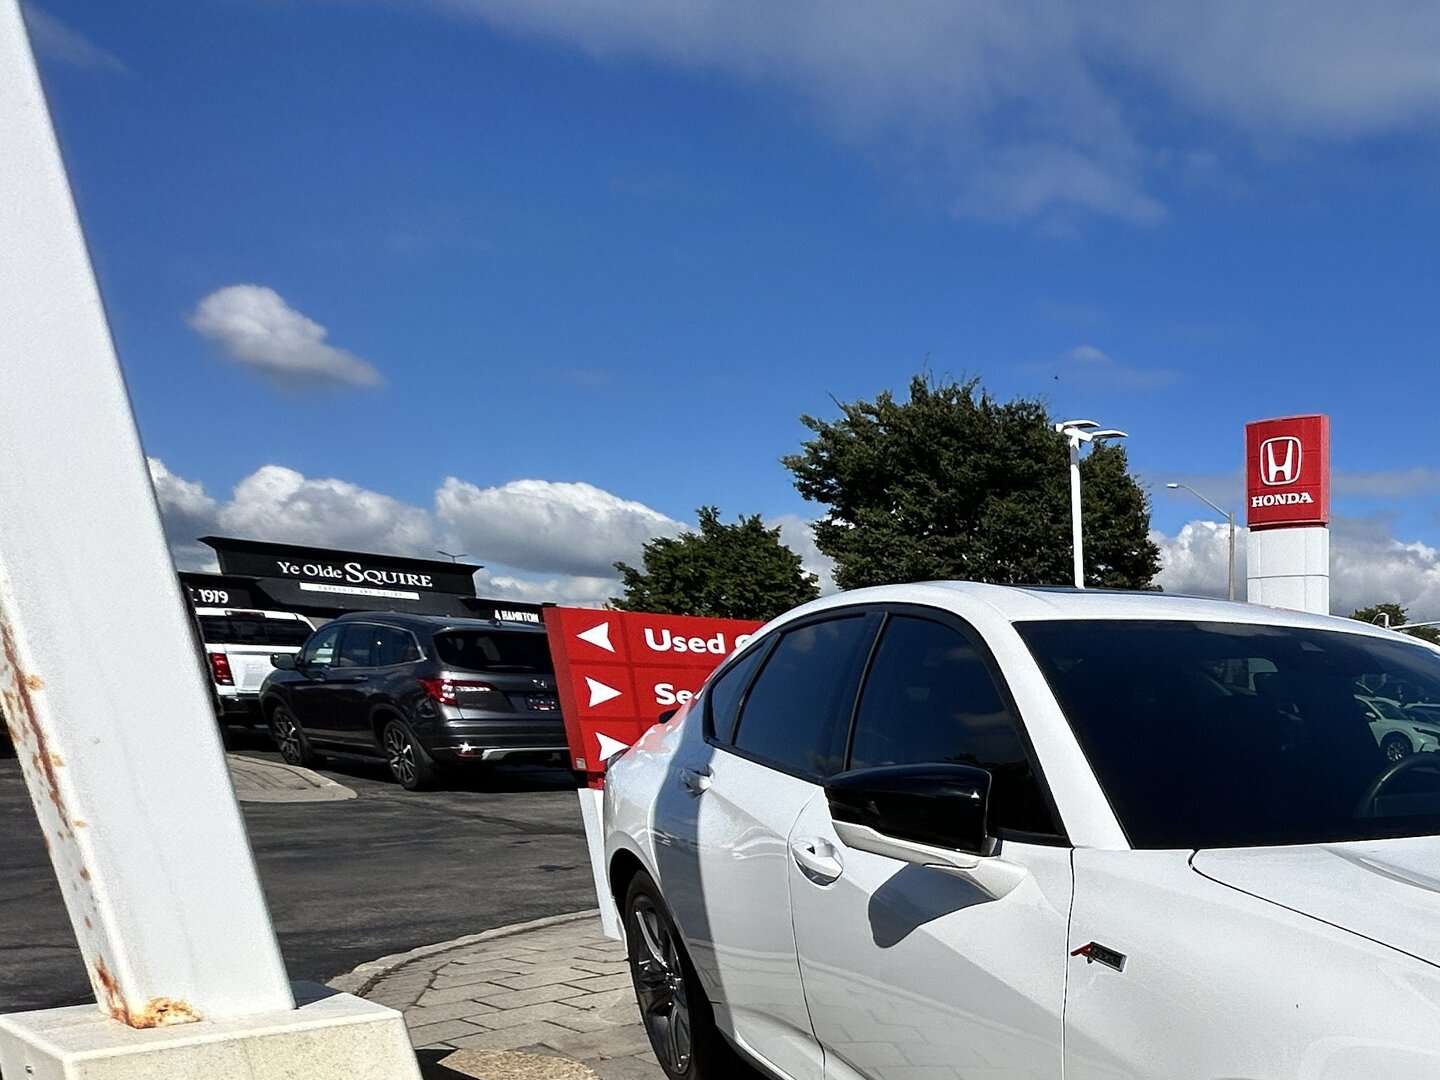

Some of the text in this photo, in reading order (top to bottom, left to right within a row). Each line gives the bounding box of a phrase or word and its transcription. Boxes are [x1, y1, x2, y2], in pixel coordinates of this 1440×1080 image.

[1251, 492, 1314, 507] HONDA
[277, 561, 433, 588] Ye Olde SQUIRE
[643, 627, 727, 654] Used
